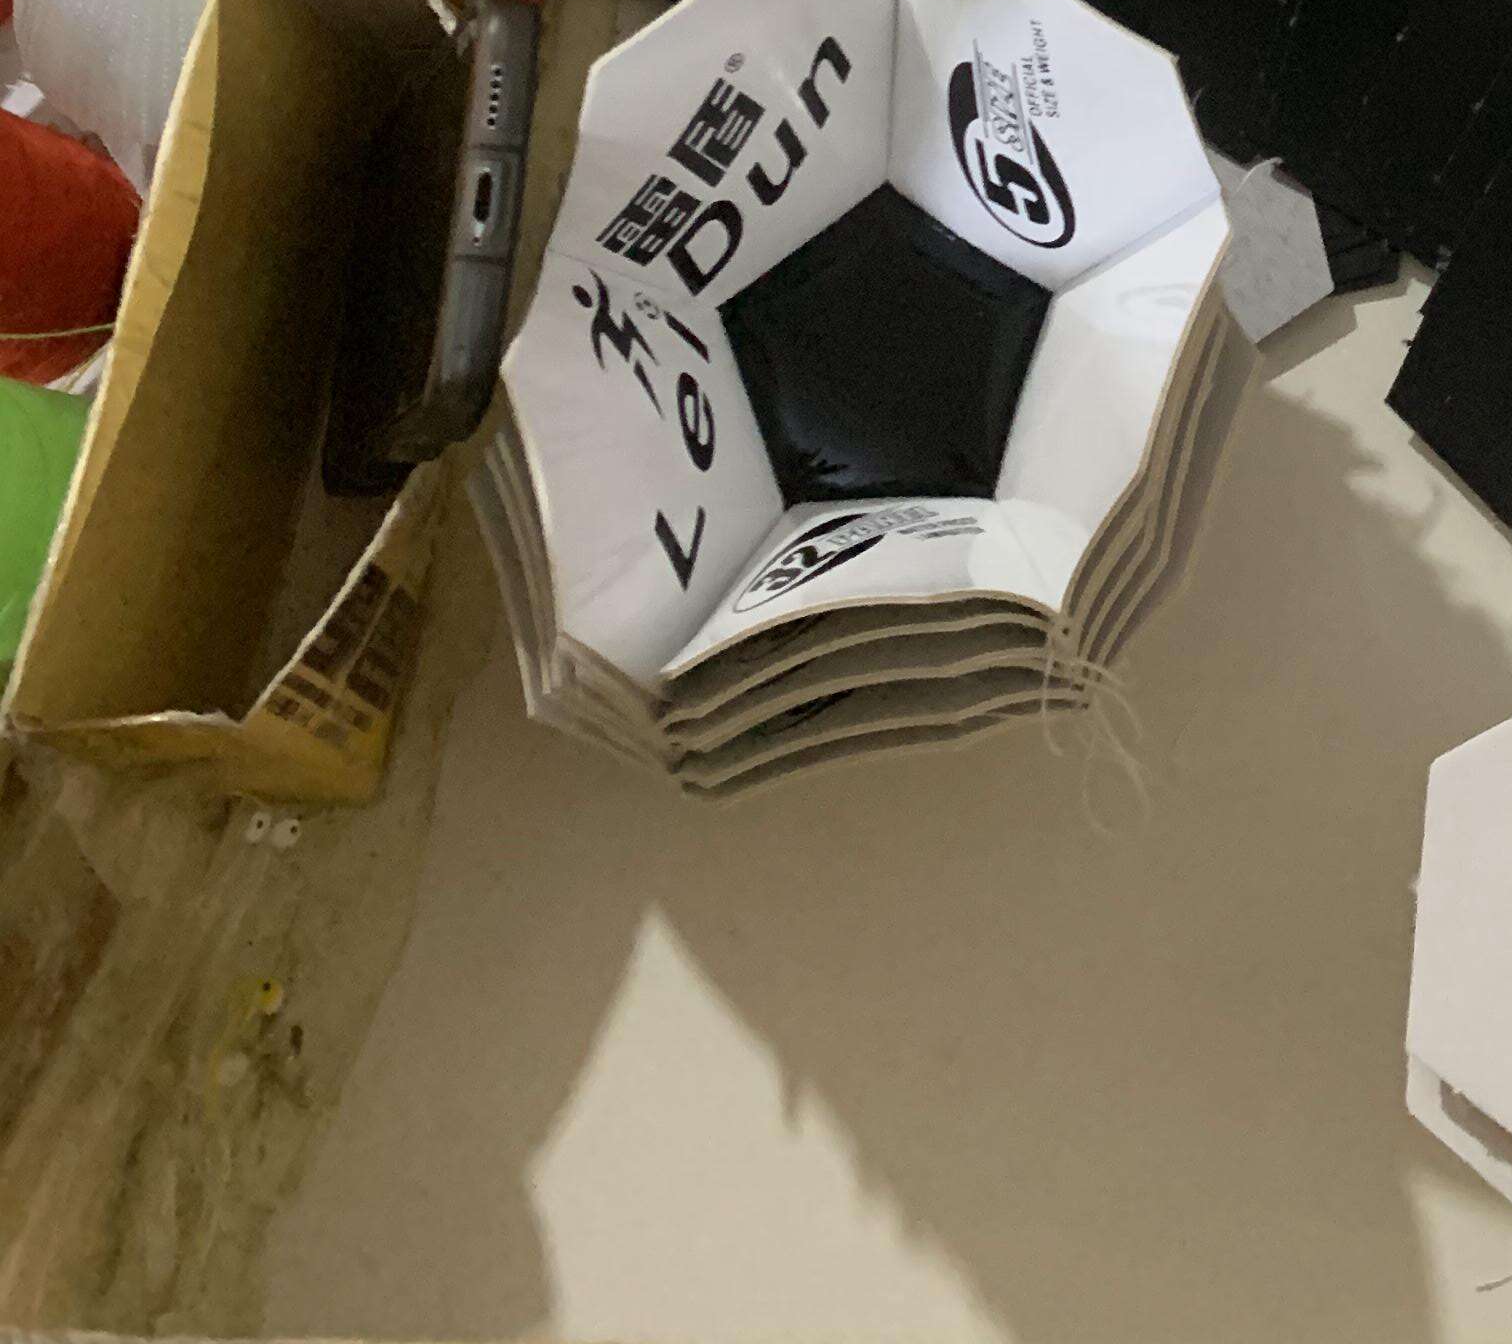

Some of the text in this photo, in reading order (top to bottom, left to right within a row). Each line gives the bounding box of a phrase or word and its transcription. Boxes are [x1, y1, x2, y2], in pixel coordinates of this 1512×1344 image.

[1030, 19, 1052, 73] WEIGHT
[1021, 57, 1043, 118] OFFICIAL
[1042, 92, 1060, 119] SIZE
[596, 76, 765, 266] 雷盾
[666, 36, 852, 296] Dun
[976, 138, 1050, 225] 5
[749, 545, 837, 592] 32
